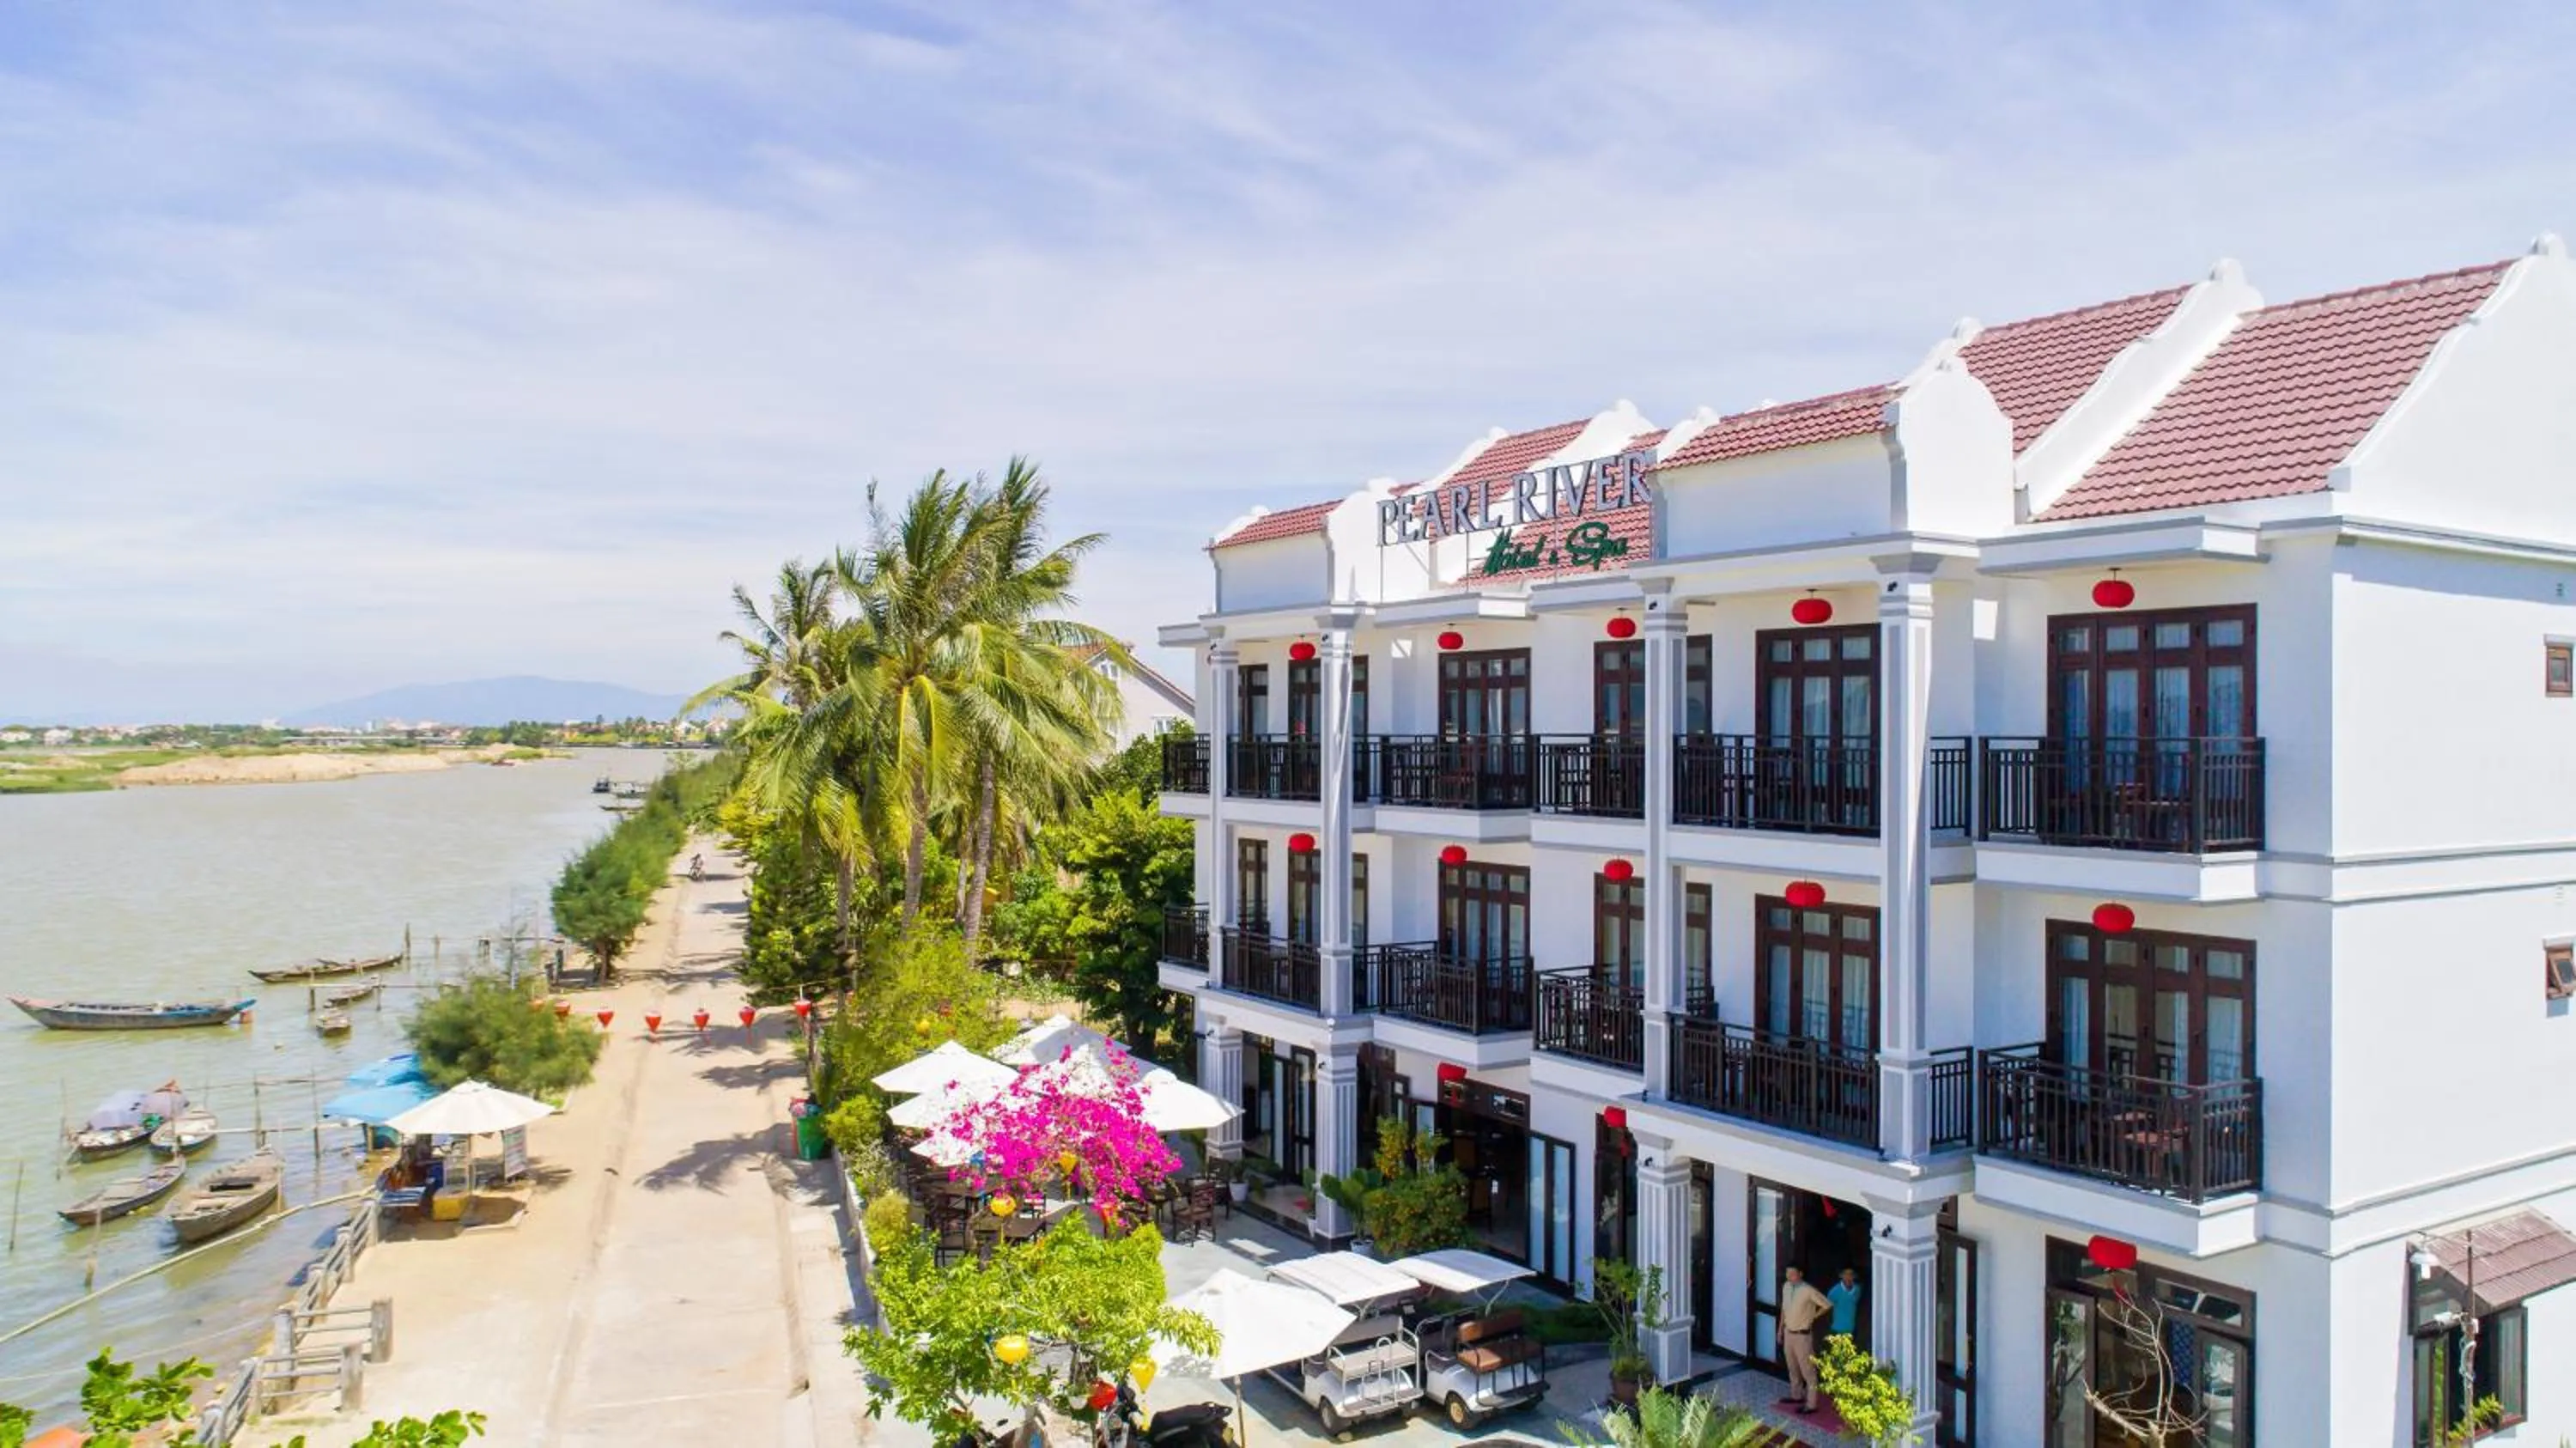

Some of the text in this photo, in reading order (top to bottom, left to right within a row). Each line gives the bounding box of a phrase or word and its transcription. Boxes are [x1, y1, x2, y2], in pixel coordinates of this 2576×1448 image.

[1376, 450, 1653, 547] PEARL RIVER
[1482, 527, 1547, 576] Hotel
[1565, 521, 1629, 570] Spa
